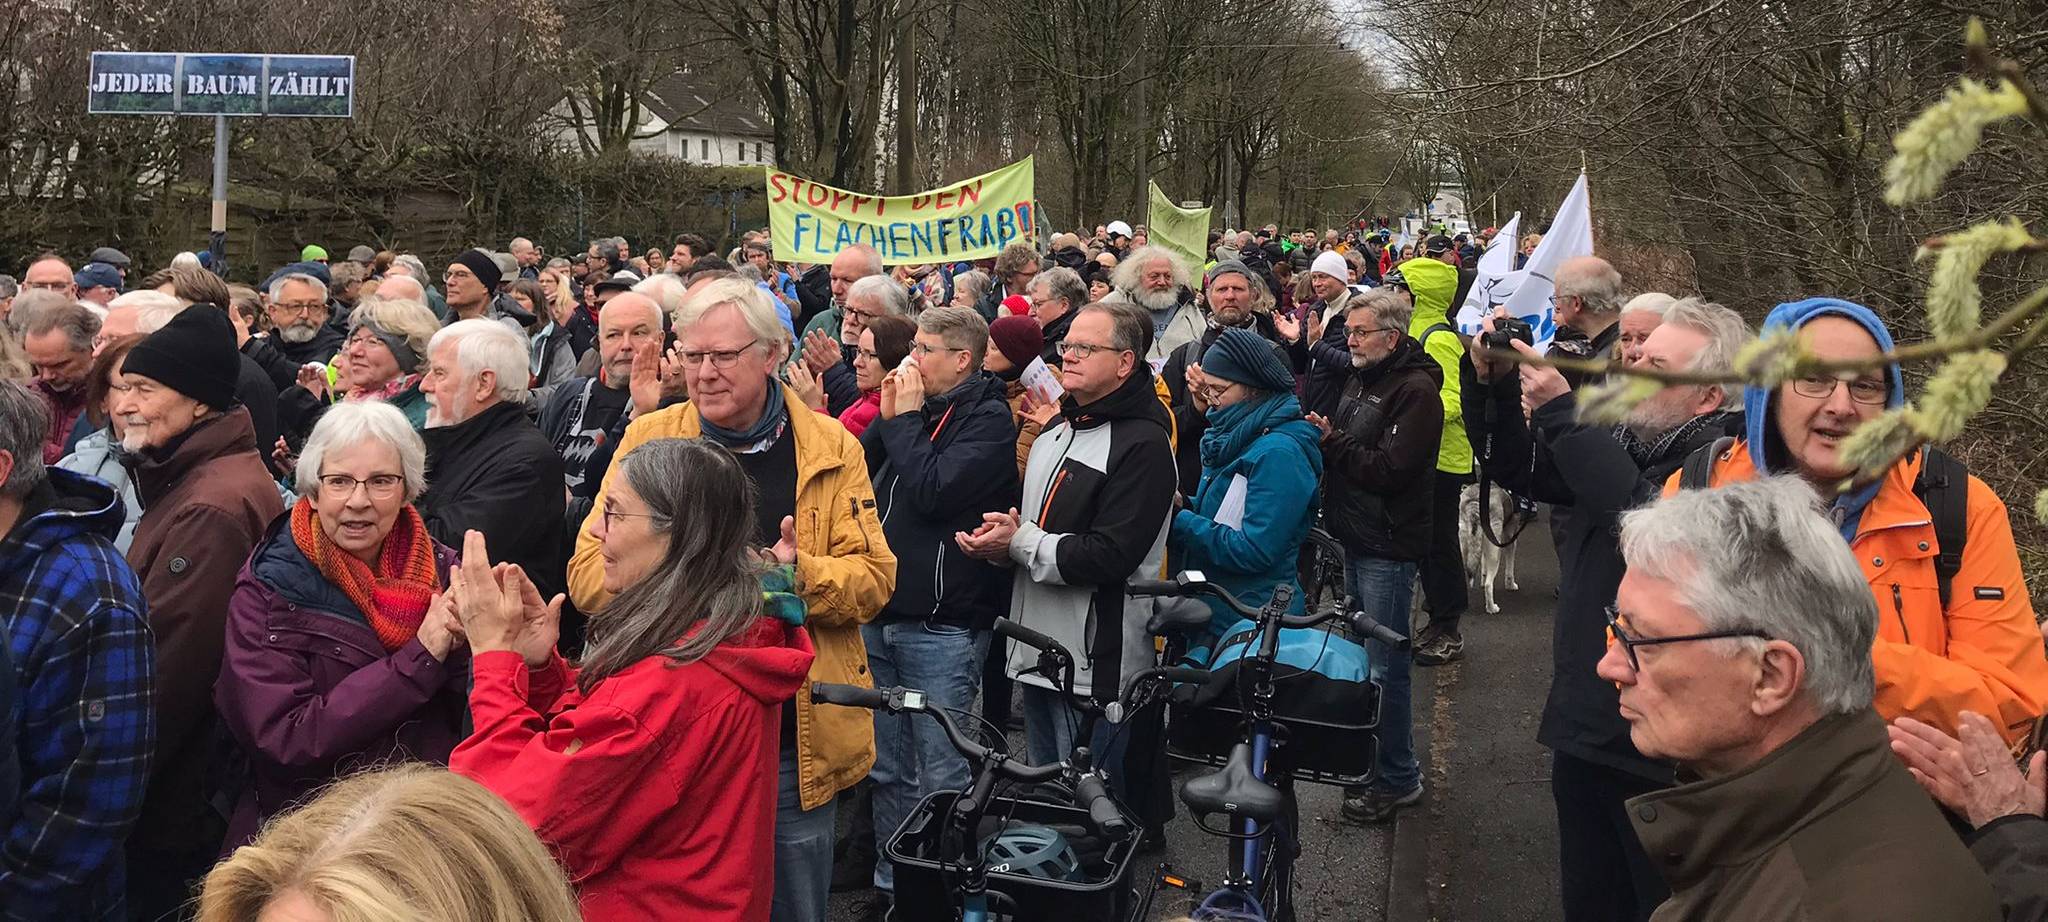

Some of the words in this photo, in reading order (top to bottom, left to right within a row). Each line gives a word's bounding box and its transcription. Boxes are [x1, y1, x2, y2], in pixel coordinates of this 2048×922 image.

[92, 73, 173, 93] JEDER
[187, 74, 256, 95] BAUM
[270, 72, 348, 97] ZÄHLT
